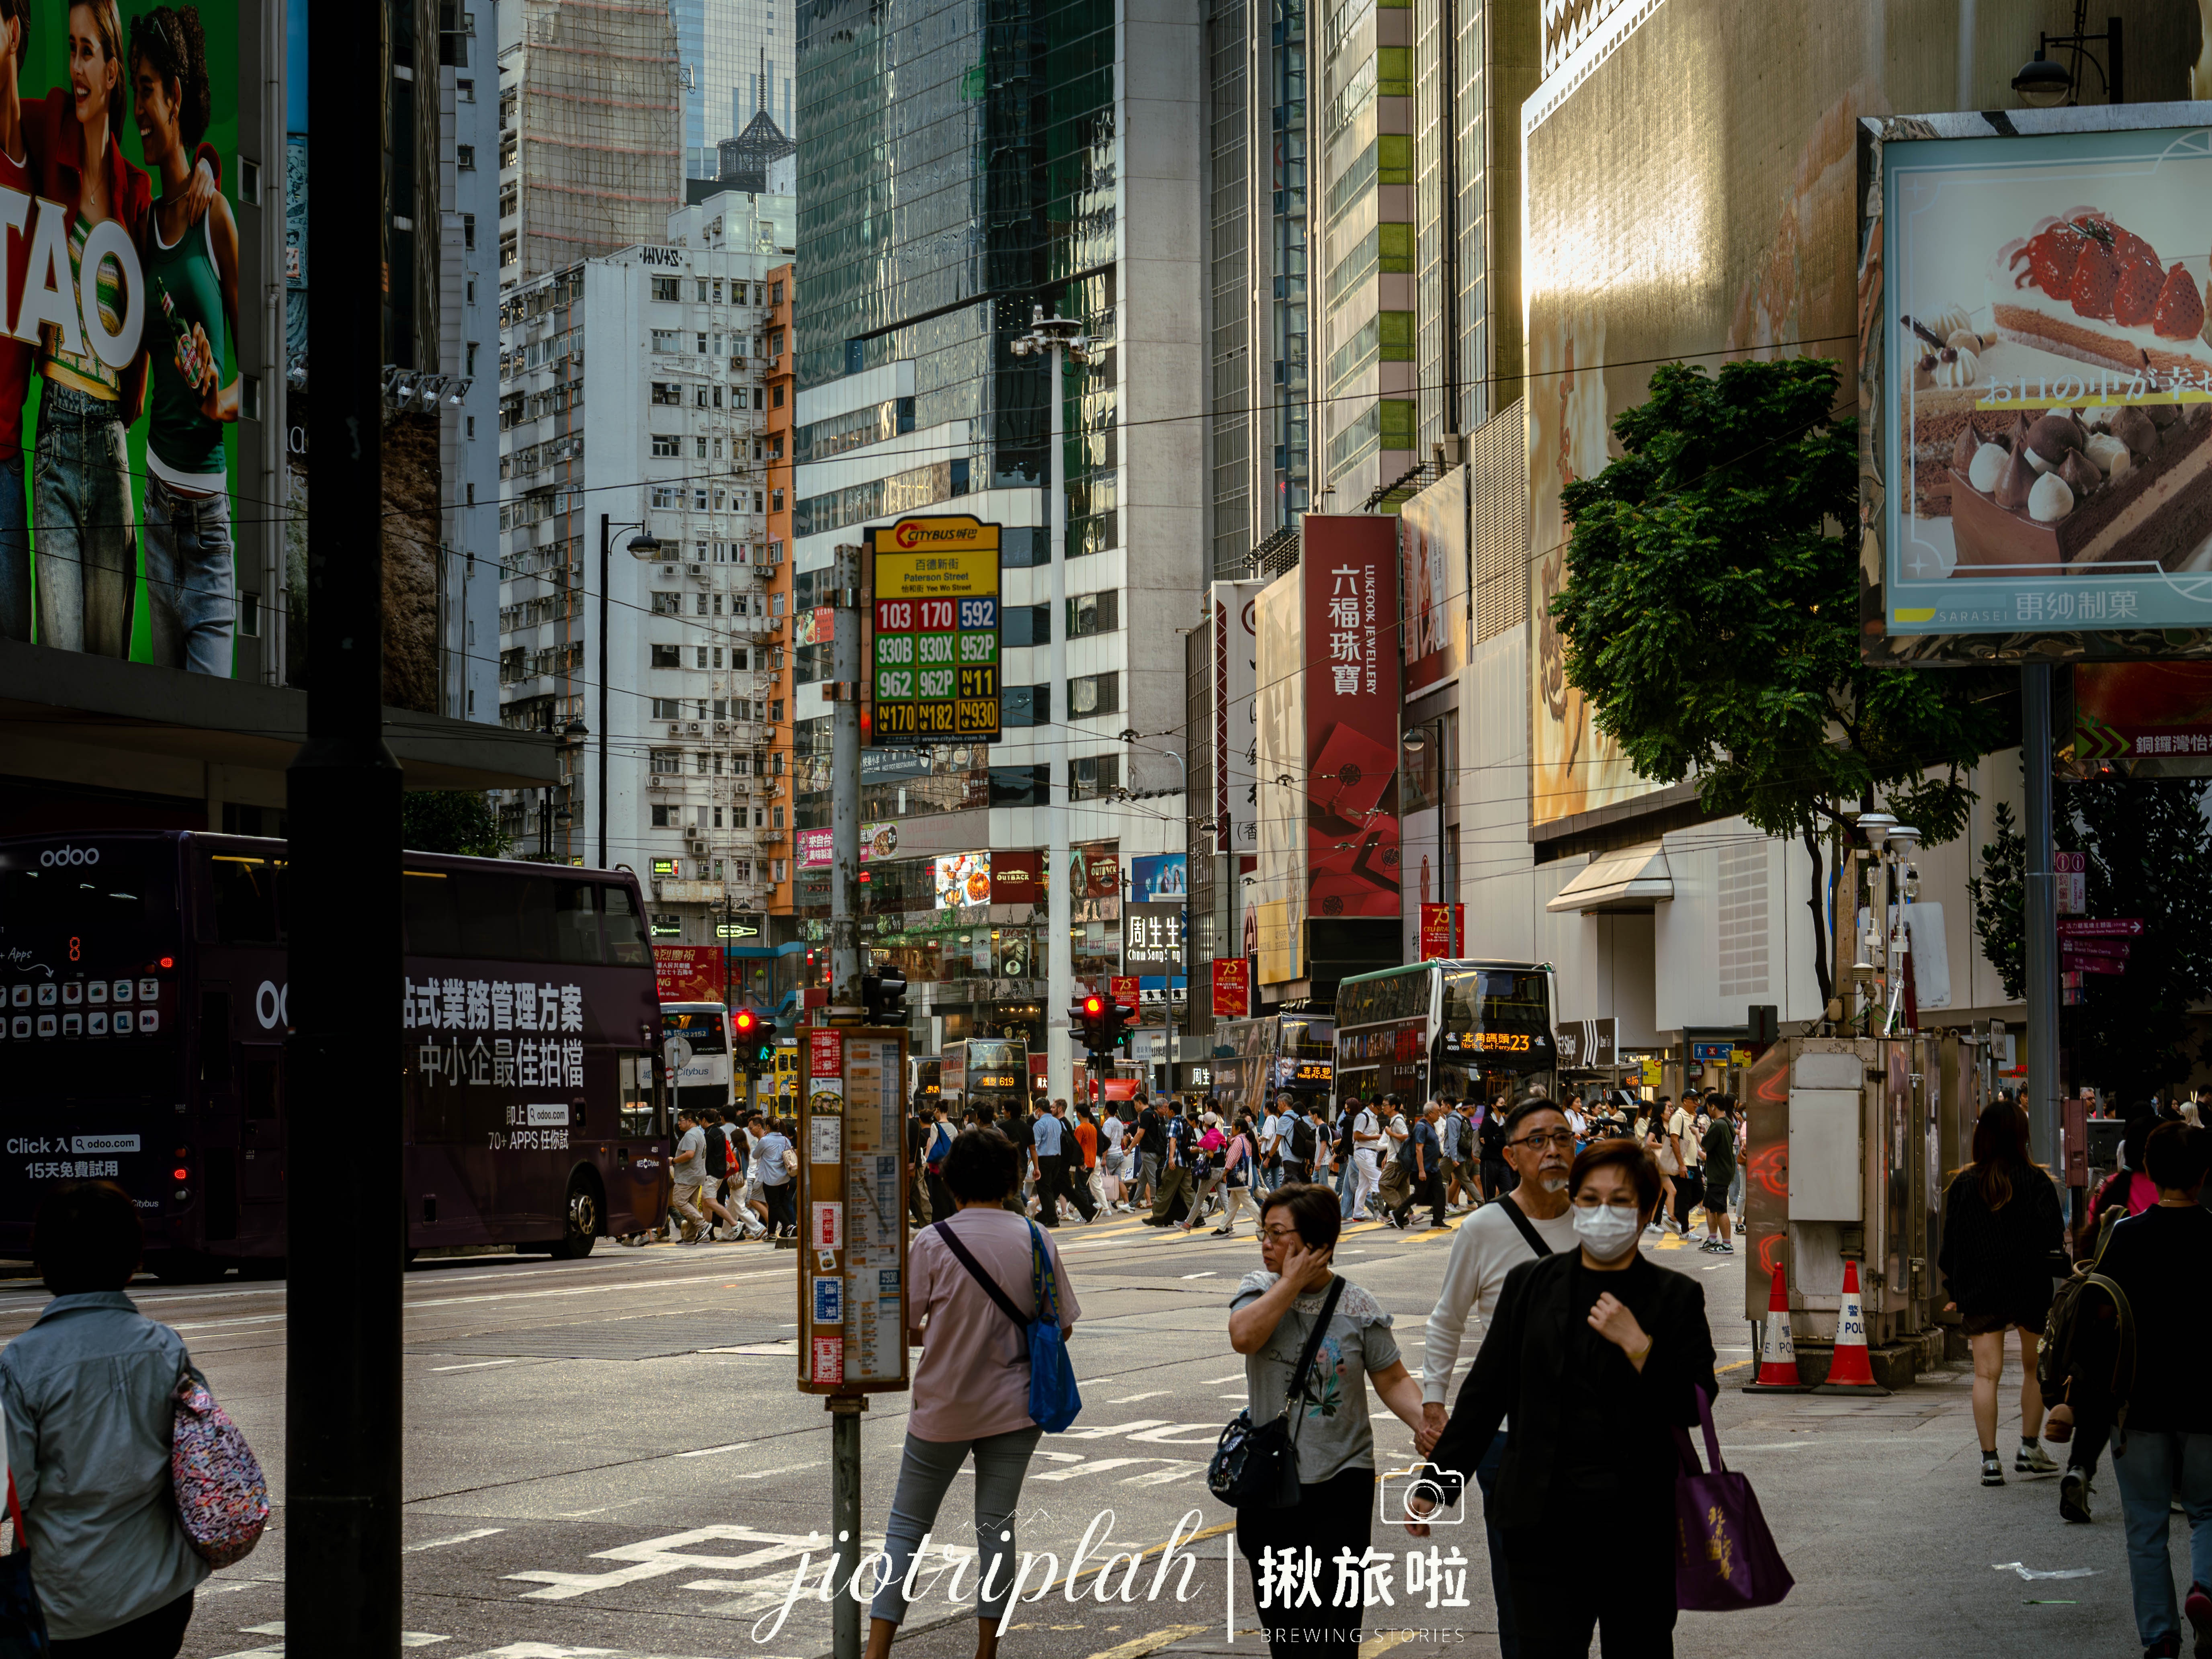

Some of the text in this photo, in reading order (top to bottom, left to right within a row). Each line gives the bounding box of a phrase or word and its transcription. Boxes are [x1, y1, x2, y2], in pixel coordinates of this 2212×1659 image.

[908, 528, 978, 541] CITYBUS 城巴
[916, 558, 959, 571] 百德新街
[904, 572, 969, 582] Paterson Street
[880, 601, 994, 629] 103 170 592
[1939, 611, 2007, 623] SARASEI
[1327, 564, 1362, 696] 六福珠寶
[1364, 565, 1376, 695] LUKFOOK JEWELLERY
[879, 634, 995, 664] 930B 930X 952P
[880, 669, 992, 697] 962 962P N11
[880, 702, 995, 731] N170 N182 N930
[922, 735, 987, 743] www.citybus.com.hk
[896, 760, 917, 768] RESTAURANT
[888, 834, 896, 844] 2/F
[41, 844, 99, 867] odoo
[1091, 866, 1116, 876] OUTBACK
[1432, 906, 1449, 926] 75
[1128, 916, 1180, 949] 周生生
[69, 937, 80, 961] 8
[1090, 940, 1102, 950] UCC
[1107, 942, 1119, 952] UCC
[8, 946, 33, 963] Apps
[976, 952, 987, 962] UCC
[1128, 949, 1180, 963] Chow Sang Sng
[1222, 961, 1239, 976] 75
[1118, 978, 1133, 991] 75
[1462, 1032, 1510, 1044] 北角碼頭
[1510, 1035, 1530, 1051] 23
[1495, 1043, 1511, 1051] Ferry
[1564, 1034, 1576, 1060] Skip!
[420, 1036, 583, 1087] 中小企最佳拍檔
[678, 1067, 709, 1077] Citybus
[1192, 1067, 1210, 1085] 周生
[1303, 1067, 1331, 1075] 杏花邨
[999, 1077, 1014, 1086] 619
[1037, 1077, 1047, 1088] 周大
[506, 1105, 565, 1126] 即上 odoo.com
[6, 1137, 135, 1154] Click 入 odoo.com
[489, 1129, 569, 1150] 70+ APPS 任你試
[25, 1161, 119, 1179] 15天免費試用
[131, 1199, 159, 1208] Citybus
[823, 1209, 834, 1243] 通渠王
